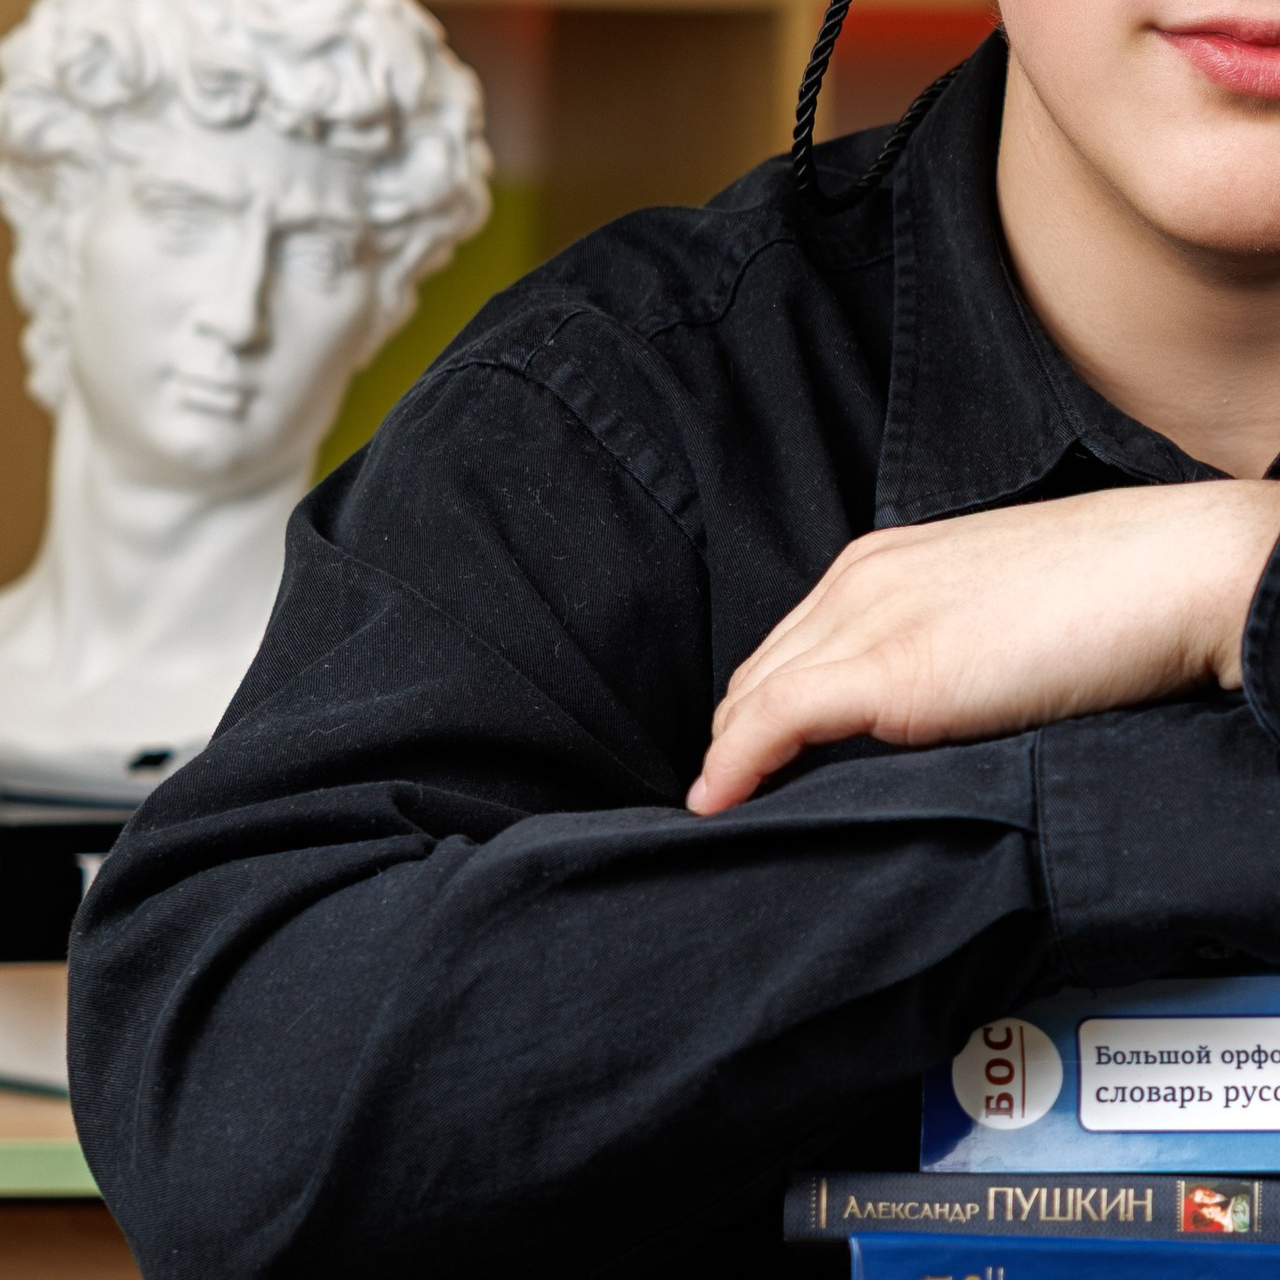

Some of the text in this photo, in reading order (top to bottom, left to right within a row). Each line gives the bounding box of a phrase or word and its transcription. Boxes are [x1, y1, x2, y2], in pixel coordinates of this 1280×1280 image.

[1094, 1045, 1212, 1066] Большой
[982, 1025, 1016, 1120] БОС
[1095, 1084, 1213, 1109] словарь
[986, 1186, 1153, 1222] ПУШКИН
